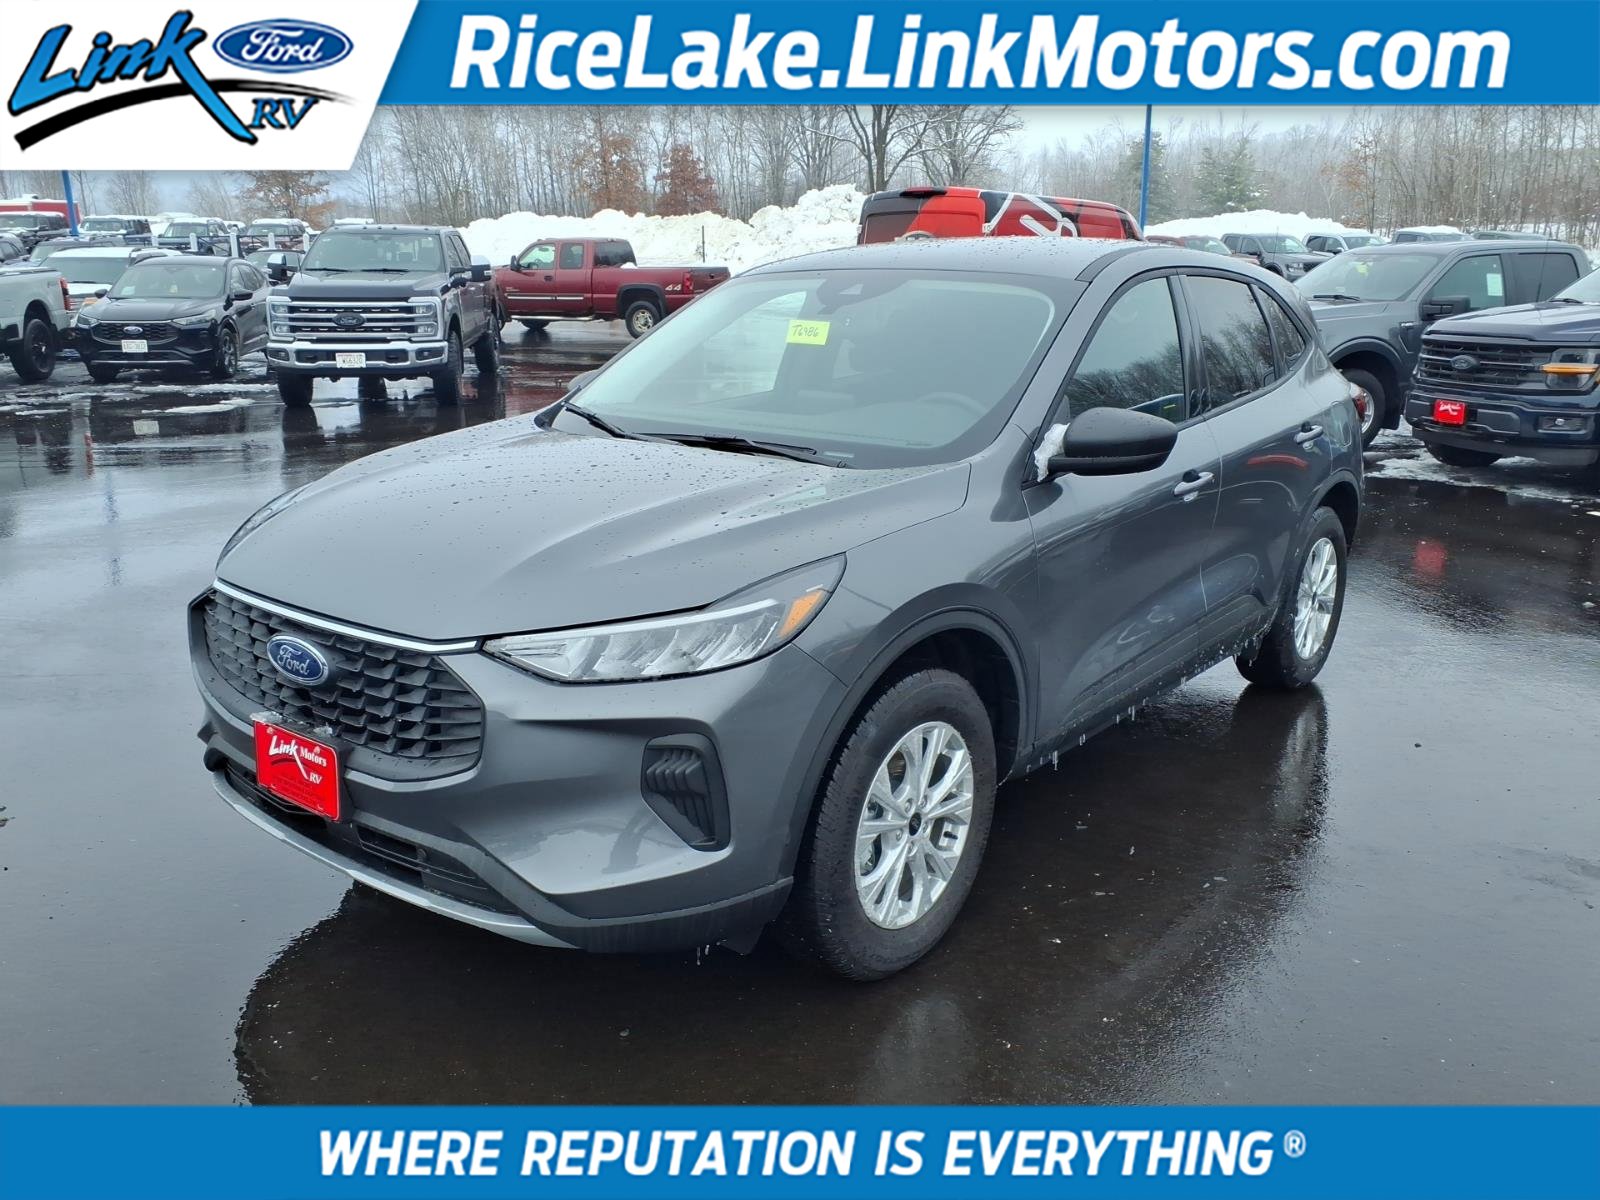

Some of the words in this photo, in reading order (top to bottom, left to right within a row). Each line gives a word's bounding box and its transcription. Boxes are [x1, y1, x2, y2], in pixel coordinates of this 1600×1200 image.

[277, 644, 310, 676] Ford
[269, 735, 309, 780] Link
[299, 745, 327, 768] Motors
[309, 771, 323, 785] RV
